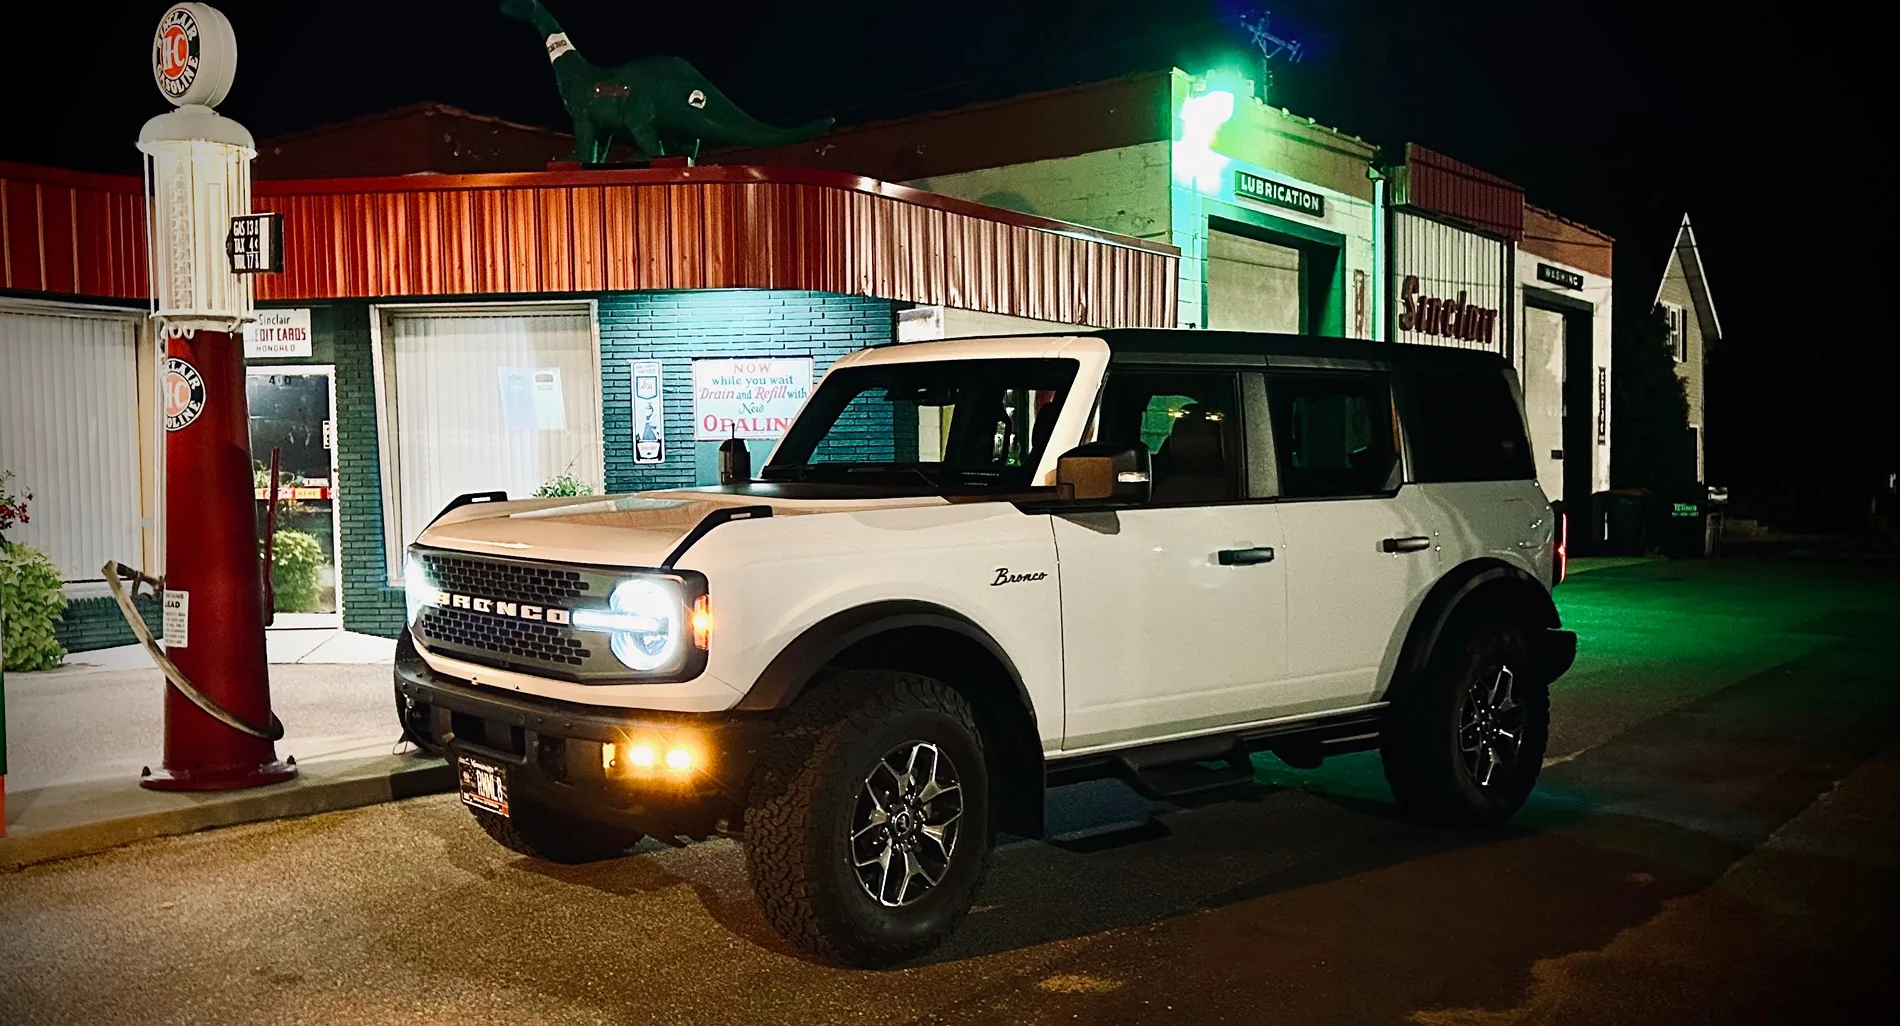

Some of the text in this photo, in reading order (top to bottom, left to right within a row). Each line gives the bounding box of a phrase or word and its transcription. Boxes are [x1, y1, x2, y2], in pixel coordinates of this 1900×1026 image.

[157, 55, 198, 94] GASOLINE
[1241, 174, 1319, 211] LUBRICATION
[233, 220, 245, 236] GAS
[1399, 275, 1497, 344] Sinclair
[258, 313, 291, 325] Sinclair
[248, 327, 306, 342] EDIT CARDS
[256, 344, 296, 352] HONORED
[167, 360, 200, 390] CLAIR
[733, 363, 771, 373] NOW
[712, 375, 794, 388] while you wait
[699, 385, 807, 403] Drain and Refill with
[167, 400, 201, 428] OLINE
[738, 402, 764, 414] New
[703, 414, 793, 432] OPALIN
[990, 567, 1048, 586] Bronco
[437, 591, 570, 625] BRONCO
